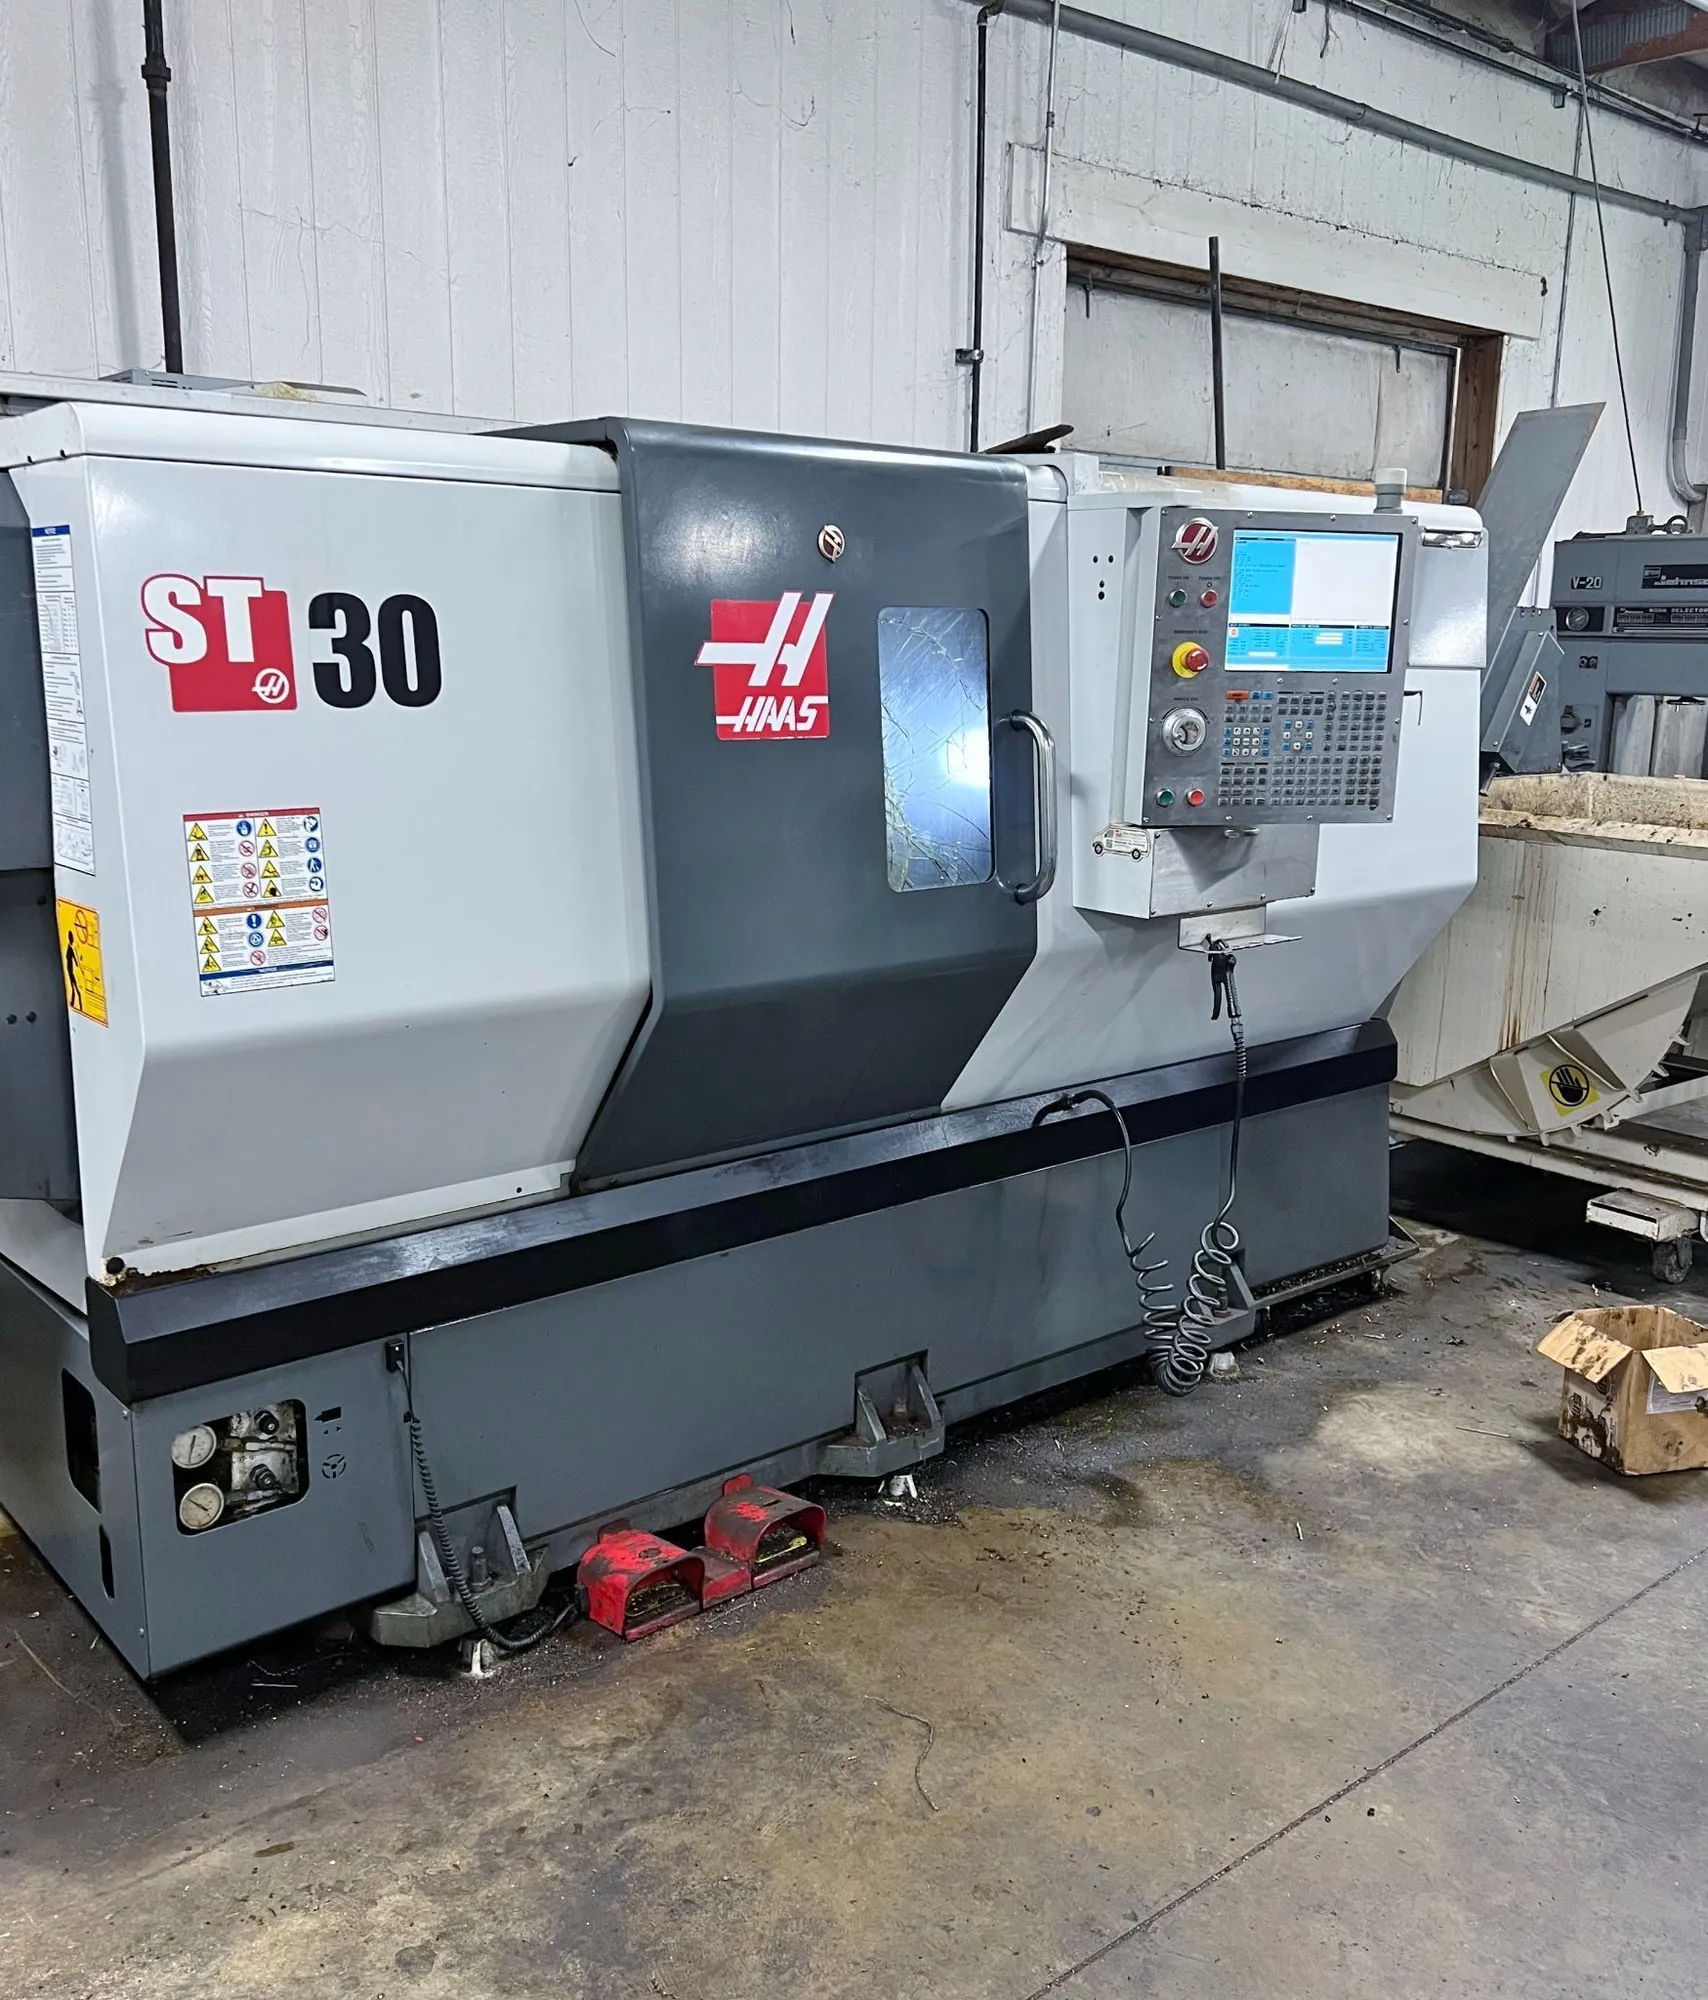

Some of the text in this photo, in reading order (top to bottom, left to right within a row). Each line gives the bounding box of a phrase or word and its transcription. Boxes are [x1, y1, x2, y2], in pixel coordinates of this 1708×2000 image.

[1572, 576, 1602, 589] V-20
[141, 574, 264, 664] ST
[308, 592, 442, 709] 30
[716, 695, 829, 732] HAAS
